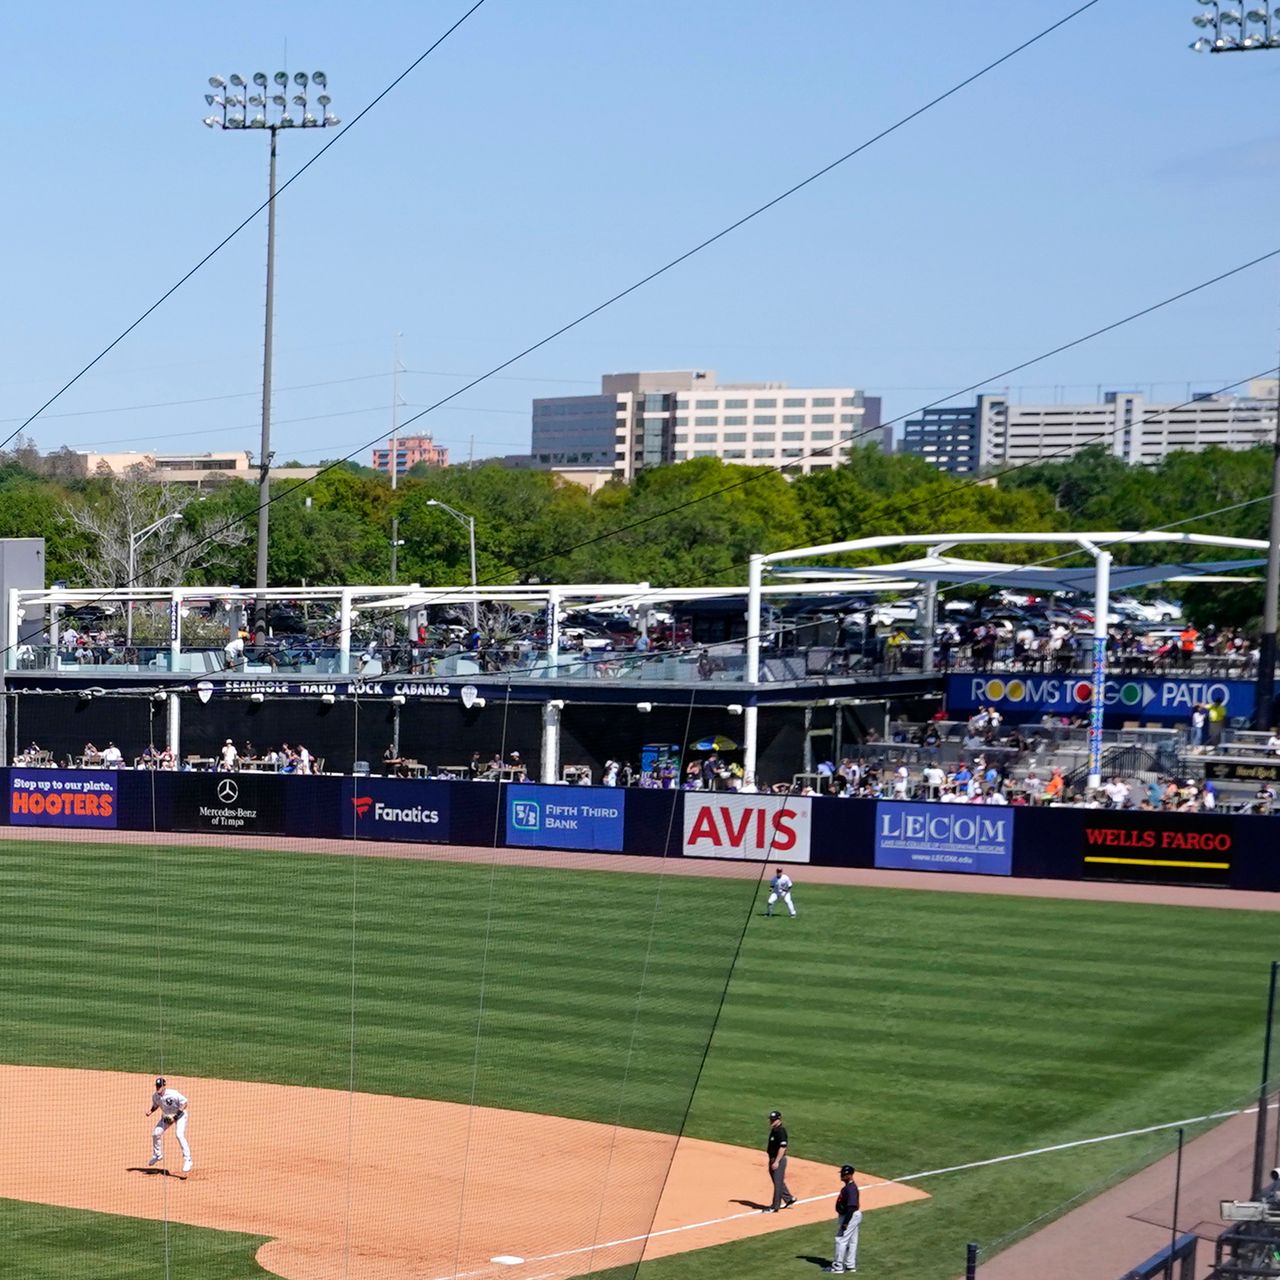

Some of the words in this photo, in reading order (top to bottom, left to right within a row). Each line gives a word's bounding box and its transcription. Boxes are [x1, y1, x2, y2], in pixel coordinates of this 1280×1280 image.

[225, 681, 289, 693] SEMINOLE
[300, 683, 337, 693] HARD
[347, 683, 383, 694] ROCK
[394, 684, 450, 696] CABANAS
[971, 678, 1059, 704] ROOMS
[1101, 680, 1143, 705] GO
[1162, 682, 1230, 707] PATIO
[38, 781, 51, 791] up
[52, 780, 63, 790] to
[64, 781, 82, 790] our
[83, 781, 114, 792] plate.
[12, 791, 113, 817] HOOTERS
[545, 804, 578, 817] FIFTH
[581, 806, 619, 819] THIRD
[200, 806, 257, 819] Mercedes-Benz
[374, 803, 439, 824] Fanatics
[212, 817, 219, 825] of
[220, 817, 244, 828] Tampa
[545, 817, 578, 830] BANK
[687, 806, 797, 851] AVIS
[1086, 828, 1155, 848] WELLS
[1161, 830, 1231, 851] FARGO
